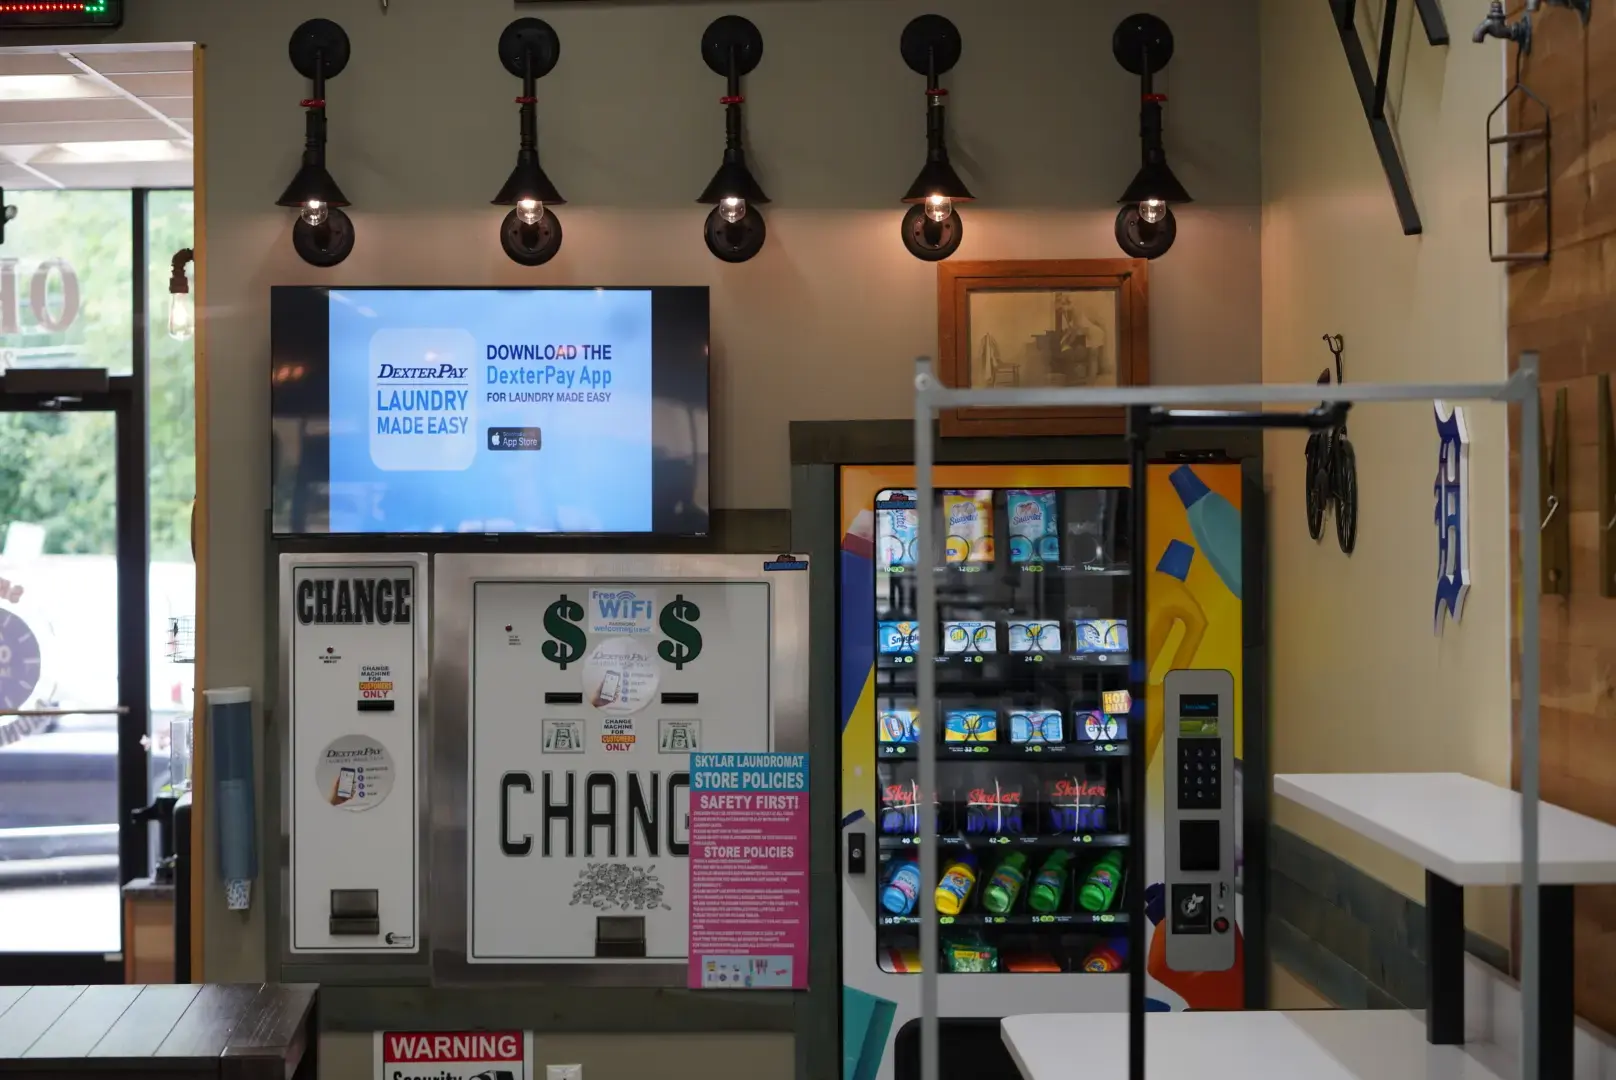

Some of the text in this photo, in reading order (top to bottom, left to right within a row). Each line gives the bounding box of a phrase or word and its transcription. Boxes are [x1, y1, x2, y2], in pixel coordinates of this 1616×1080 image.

[487, 345, 611, 360] DOWNLOAD THE
[487, 365, 611, 388] DexterPay App
[377, 390, 468, 411] LAUNDRY
[487, 392, 611, 402] FOR LAUNDRY MADE EASY
[377, 417, 468, 434] MADE EASY
[503, 437, 537, 447] App Store
[297, 578, 411, 626] CHANGE
[592, 590, 616, 600] Free
[599, 600, 652, 619] WiFi
[363, 690, 389, 698] ONLY
[1104, 692, 1126, 703] HOT
[695, 755, 804, 768] SKYLAR LAUNDROMAT
[695, 772, 804, 789] STORE POLICIES
[700, 795, 799, 809] SAFETY FIRST!
[500, 770, 690, 858] CHANG
[704, 846, 794, 858] STORE POLICIES
[391, 1036, 517, 1059] WARNING
